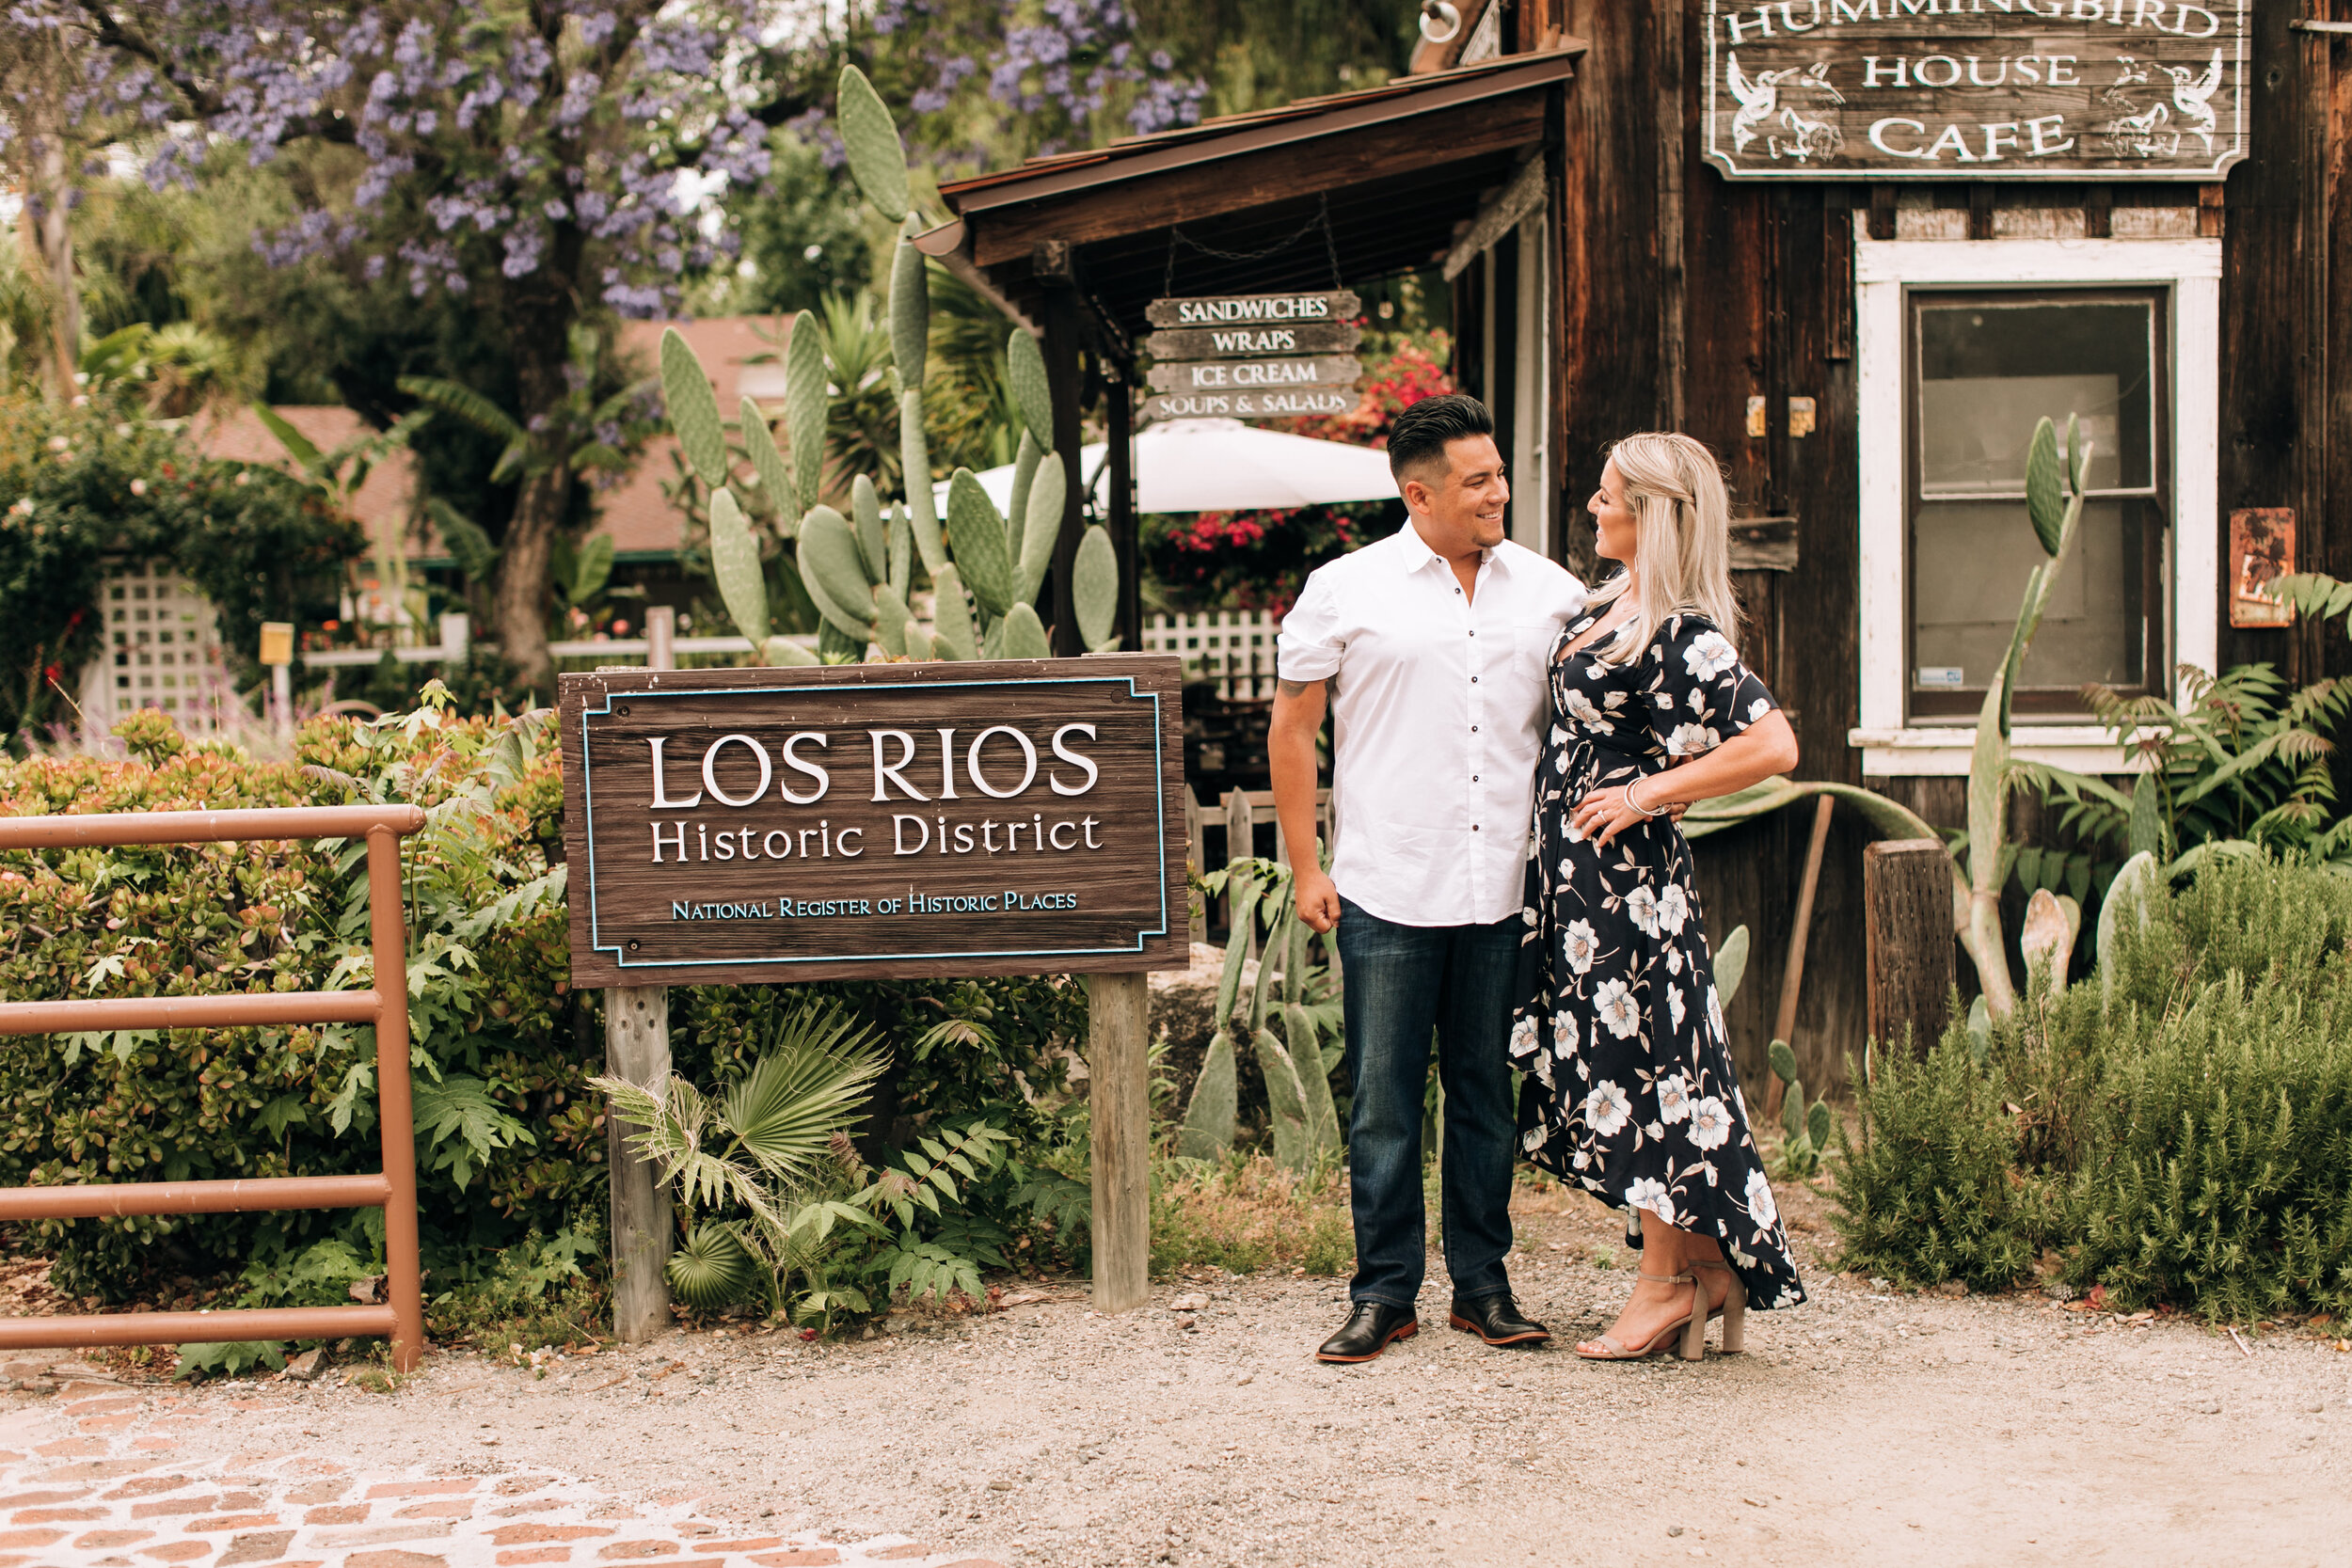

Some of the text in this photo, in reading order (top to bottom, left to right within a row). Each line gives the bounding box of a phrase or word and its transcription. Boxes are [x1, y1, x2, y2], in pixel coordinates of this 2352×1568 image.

[1862, 55, 2080, 88] HOUSE
[1867, 114, 2075, 163] CAFE
[1179, 297, 1328, 323] SANDWICHES
[1212, 330, 1296, 352] WRAPS
[1191, 361, 1318, 387] ICE CREAM
[1158, 393, 1347, 416] SOUPS & SALADS
[646, 722, 1100, 810] LOS RIOS
[649, 813, 1104, 863] Historic District
[672, 889, 1078, 921] NATIONAL REGISTER OF HISTORIC PLACES
